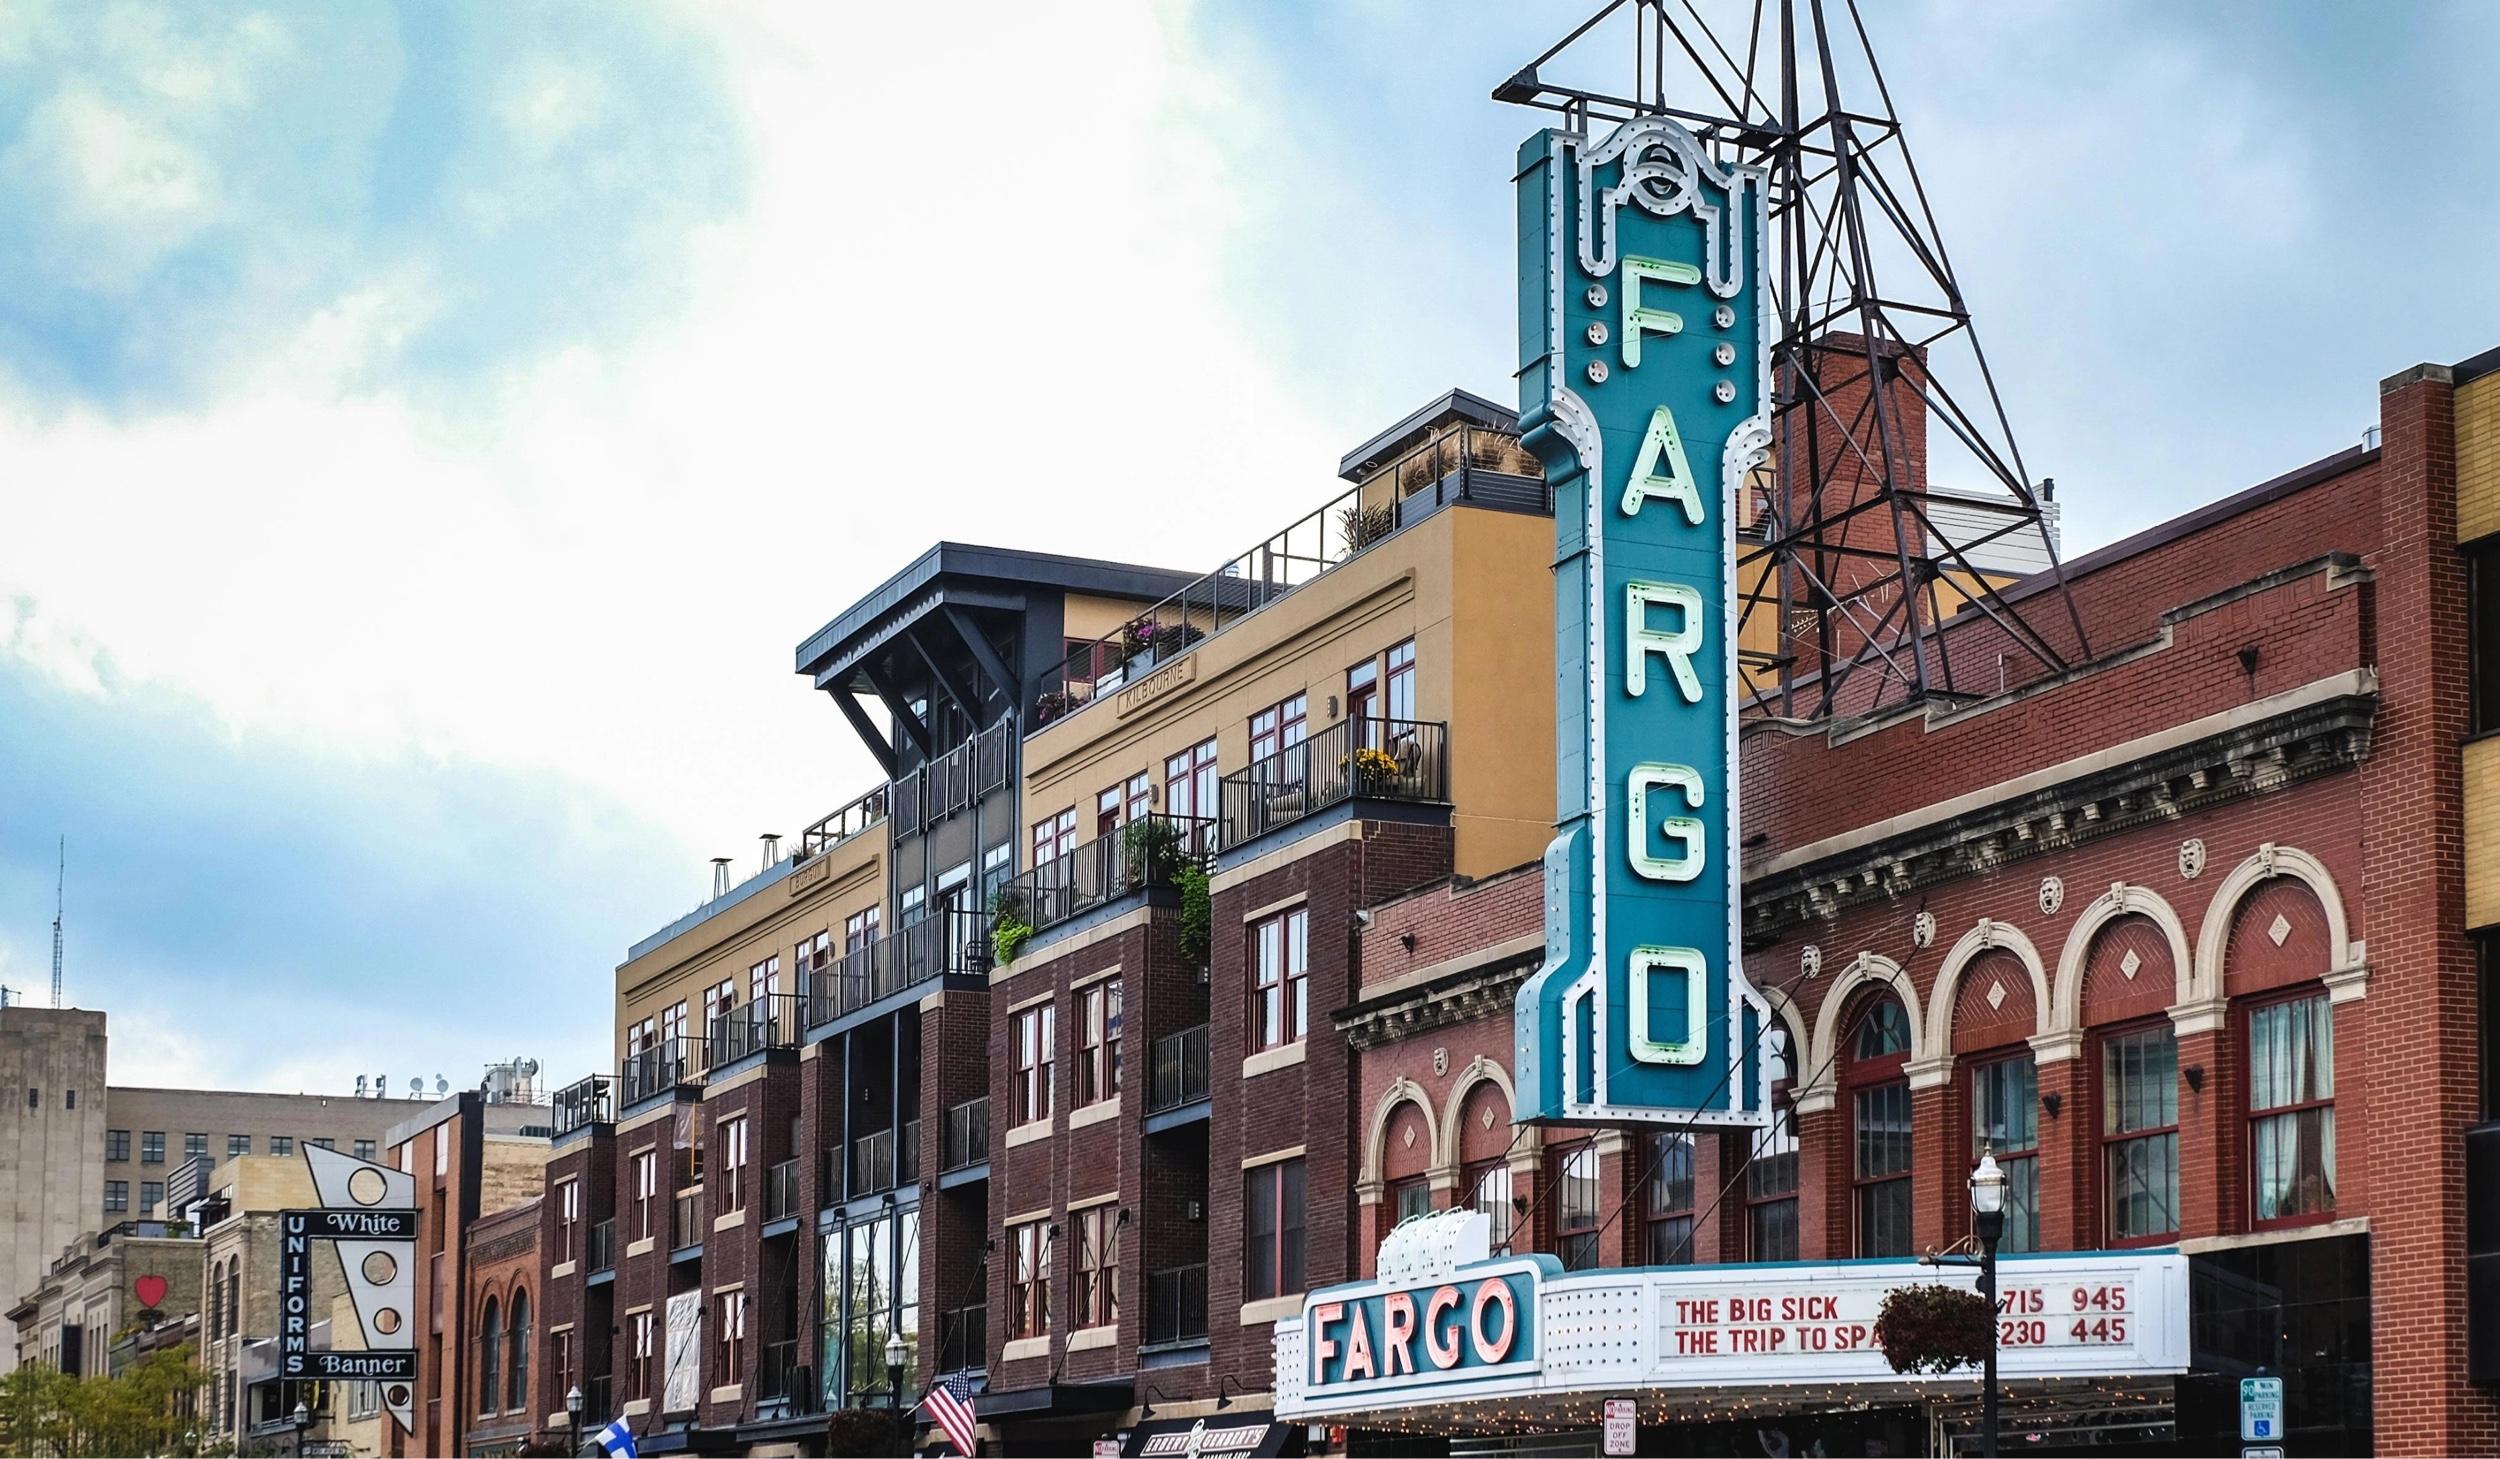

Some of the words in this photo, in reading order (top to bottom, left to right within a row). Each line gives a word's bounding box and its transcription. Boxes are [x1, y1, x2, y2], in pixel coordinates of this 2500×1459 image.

[1622, 254, 1707, 1066] FARGO
[1126, 663, 1183, 708] KILBOURNE
[327, 1214, 400, 1235] White
[286, 1216, 305, 1373] UNIFORMS
[2003, 1289, 2044, 1314] 715
[2072, 1287, 2125, 1312] 945
[1676, 1300, 1718, 1324] THE
[1729, 1298, 1771, 1322] BIG
[1781, 1296, 1838, 1321] SICK
[1314, 1277, 1515, 1384] FARGO
[1675, 1331, 1718, 1354] THE
[1728, 1328, 1785, 1353] TRIP
[1796, 1327, 1826, 1350] TO
[2001, 1320, 2045, 1345] 230
[2071, 1318, 2125, 1343] 445
[319, 1356, 406, 1376] Banner
[2243, 1385, 2254, 1397] 90
[1145, 1435, 1189, 1453] ERBERT
[1202, 1429, 1264, 1448] GERBERT'S
